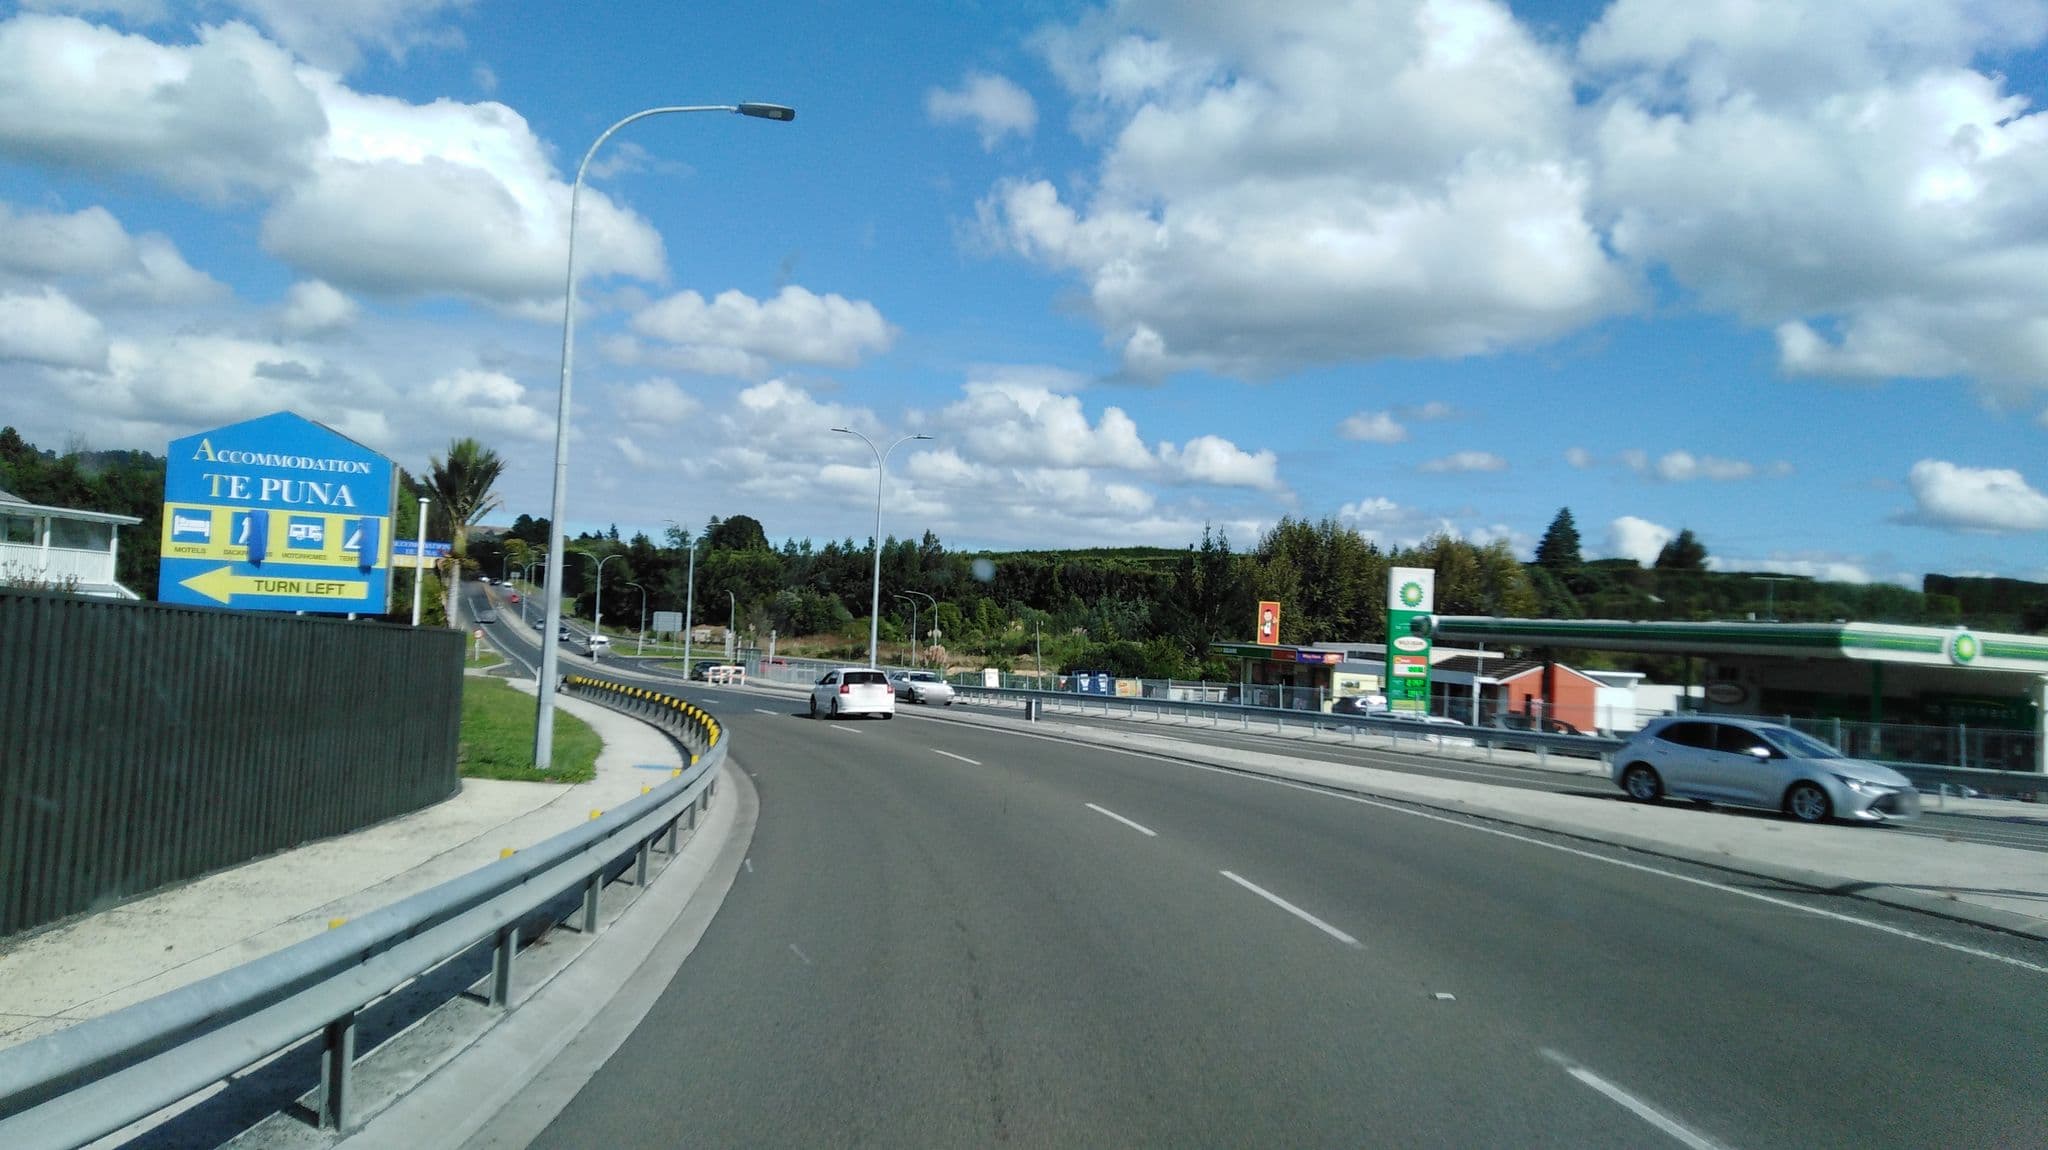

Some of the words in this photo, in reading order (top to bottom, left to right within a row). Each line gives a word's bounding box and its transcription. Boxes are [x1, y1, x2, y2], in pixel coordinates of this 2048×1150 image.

[192, 438, 371, 473] ACCOMMODATION
[203, 474, 251, 499] TE
[259, 477, 356, 507] PUNA
[174, 547, 206, 555] MOTELS
[254, 580, 301, 594] TURN
[307, 581, 345, 595] LEFT
